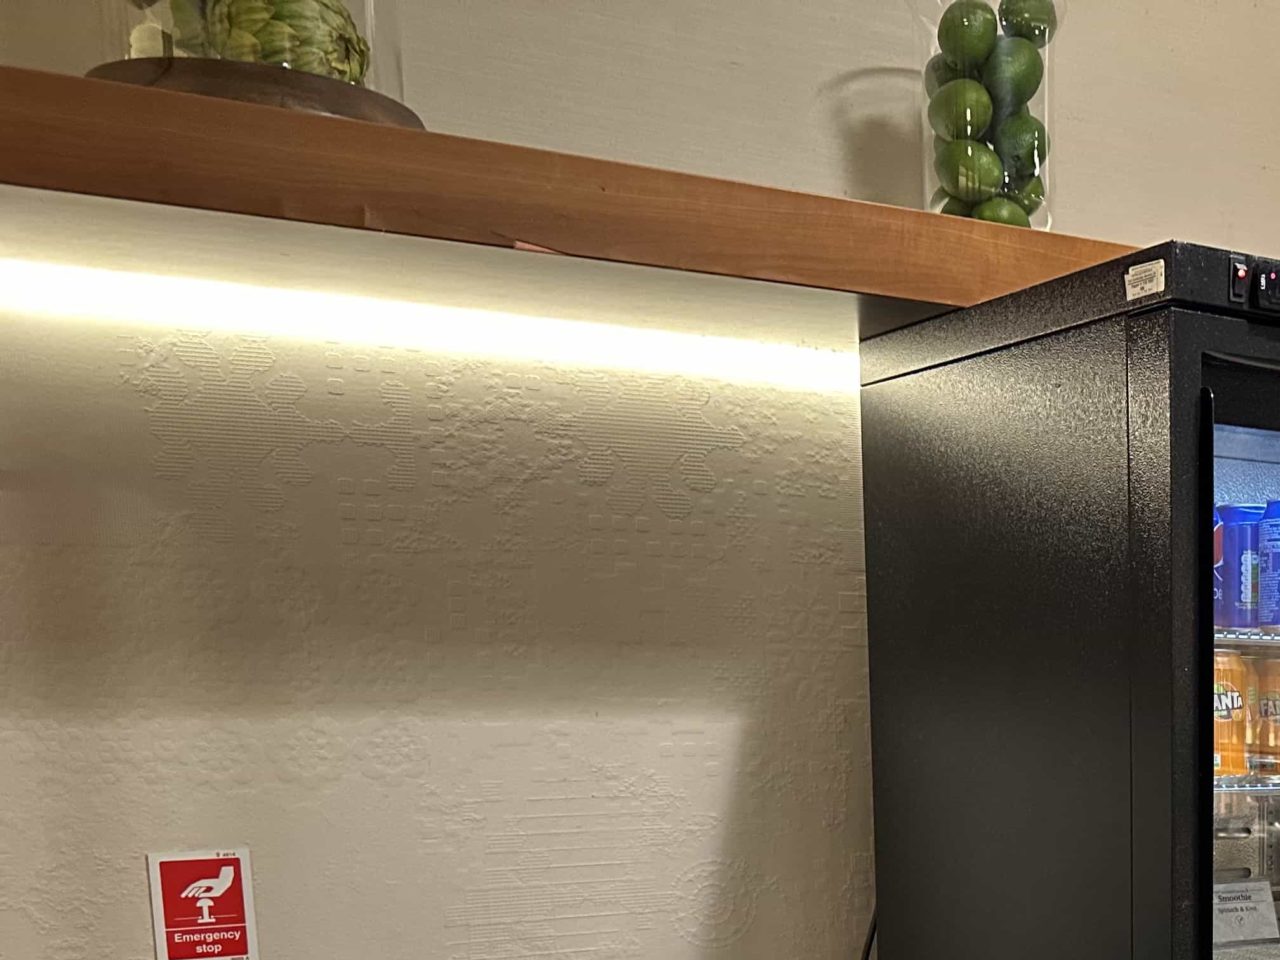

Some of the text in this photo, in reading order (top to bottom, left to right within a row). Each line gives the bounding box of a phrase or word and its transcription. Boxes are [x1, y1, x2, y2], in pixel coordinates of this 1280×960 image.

[1213, 691, 1243, 711] ANTA
[174, 930, 241, 943] Emergency
[195, 943, 223, 954] stop
